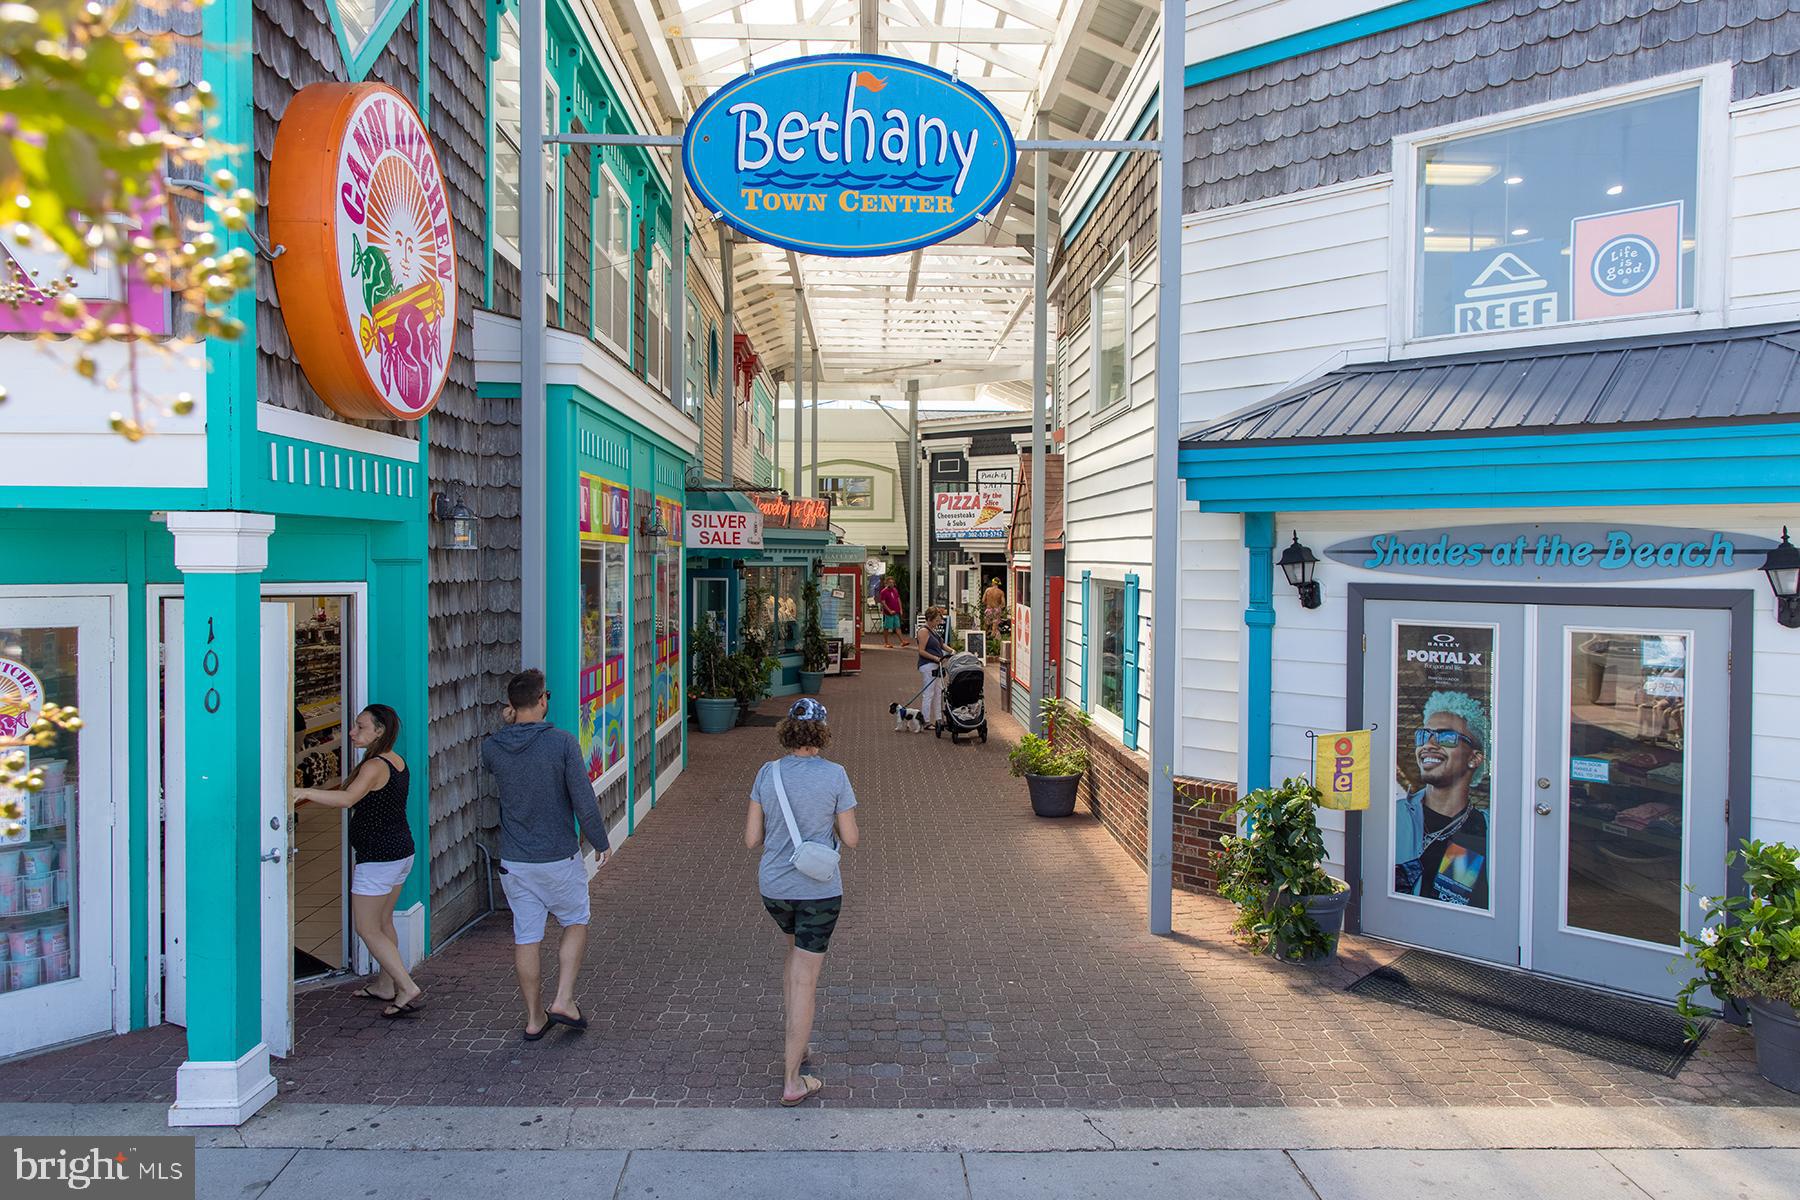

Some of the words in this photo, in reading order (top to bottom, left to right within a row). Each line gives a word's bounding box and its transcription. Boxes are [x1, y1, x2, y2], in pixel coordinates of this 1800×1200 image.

[729, 71, 979, 196] Bethany
[341, 99, 391, 225] CANDY
[392, 101, 453, 282] KITCHEN
[741, 188, 826, 212] TOWN
[839, 189, 955, 214] CENTER
[1611, 246, 1639, 262] Life
[1619, 259, 1632, 267] is
[1459, 297, 1554, 335] REEF
[1001, 471, 1008, 480] of
[936, 493, 981, 511] PIZZA
[983, 493, 991, 501] By
[579, 486, 629, 529] FUDGE
[793, 502, 804, 518] &
[937, 511, 976, 519] Cheesesteaks
[691, 514, 747, 529] SILVER
[699, 530, 741, 546] SALE
[1364, 533, 1483, 569] Shades
[1490, 534, 1531, 567] at
[1535, 531, 1595, 567] the
[1599, 531, 1734, 569] Beach
[203, 616, 220, 714] 100
[1407, 649, 1467, 665] PORTAL
[1469, 652, 1482, 666] X
